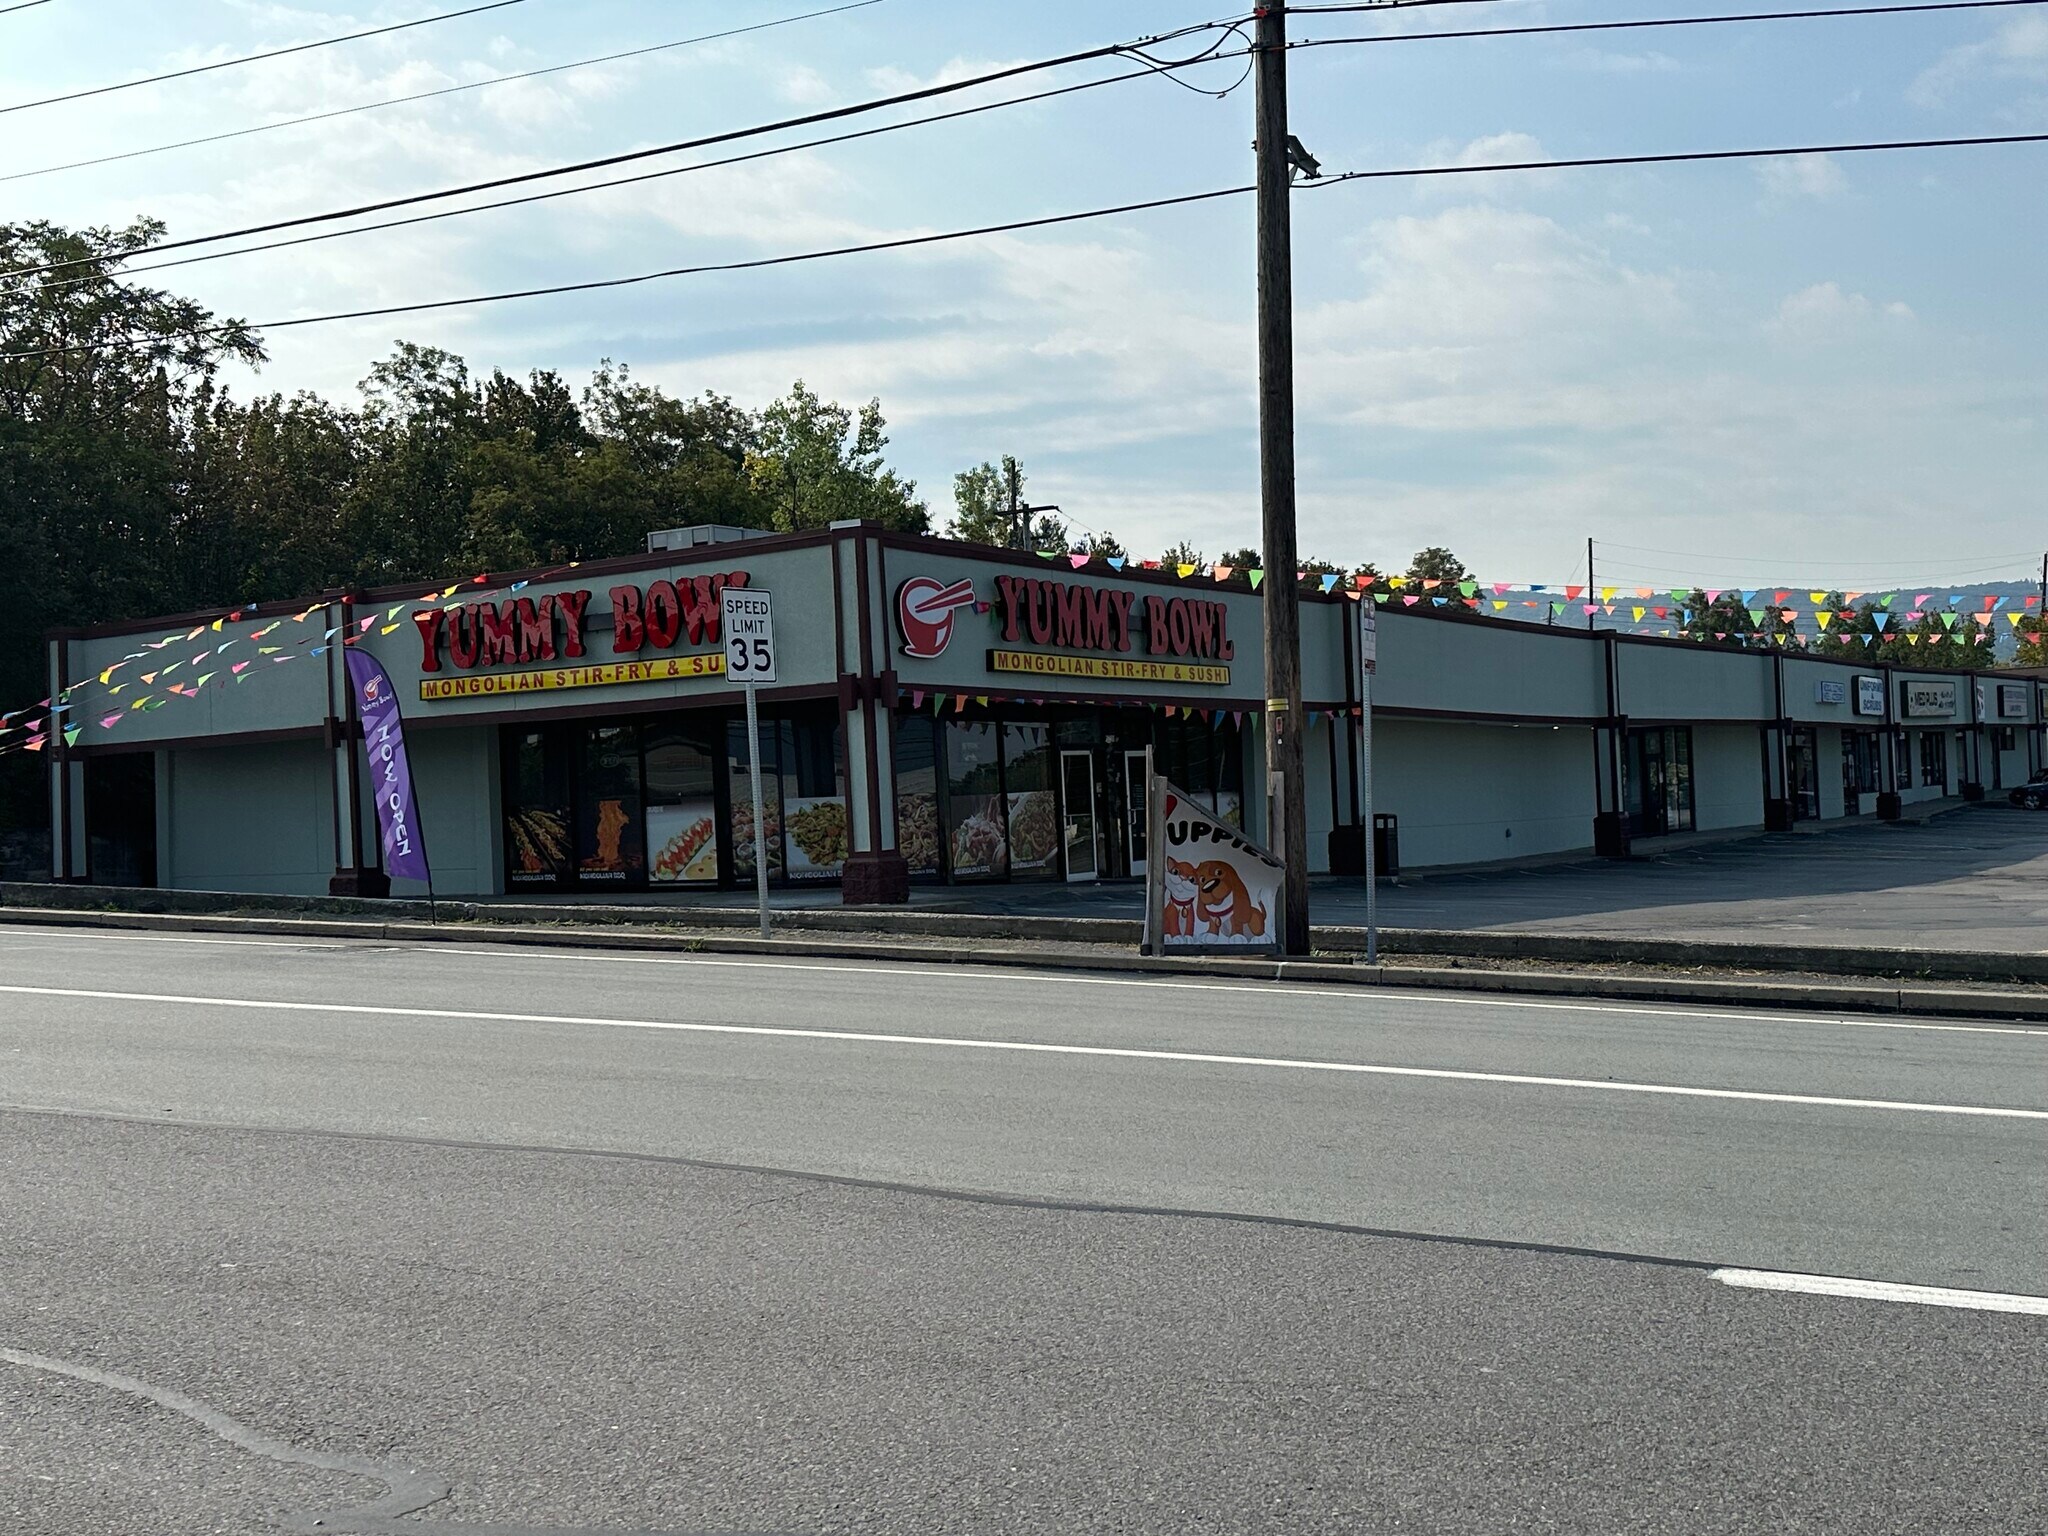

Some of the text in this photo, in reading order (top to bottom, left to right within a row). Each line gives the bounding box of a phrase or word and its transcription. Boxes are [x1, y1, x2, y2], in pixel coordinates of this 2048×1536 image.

[726, 600, 769, 615] SPEED
[732, 619, 765, 634] LIMIT
[994, 575, 1234, 661] YUMMY BOWL
[412, 590, 592, 673] YUMMY
[731, 638, 772, 672] 35
[998, 652, 1228, 682] MONGOLIAN STIR-FRY & SUSHI
[426, 672, 544, 698] MONGOLIAN
[556, 655, 654, 687] STIR-FRY
[667, 660, 679, 676] &
[377, 725, 412, 857] NOW OPEN
